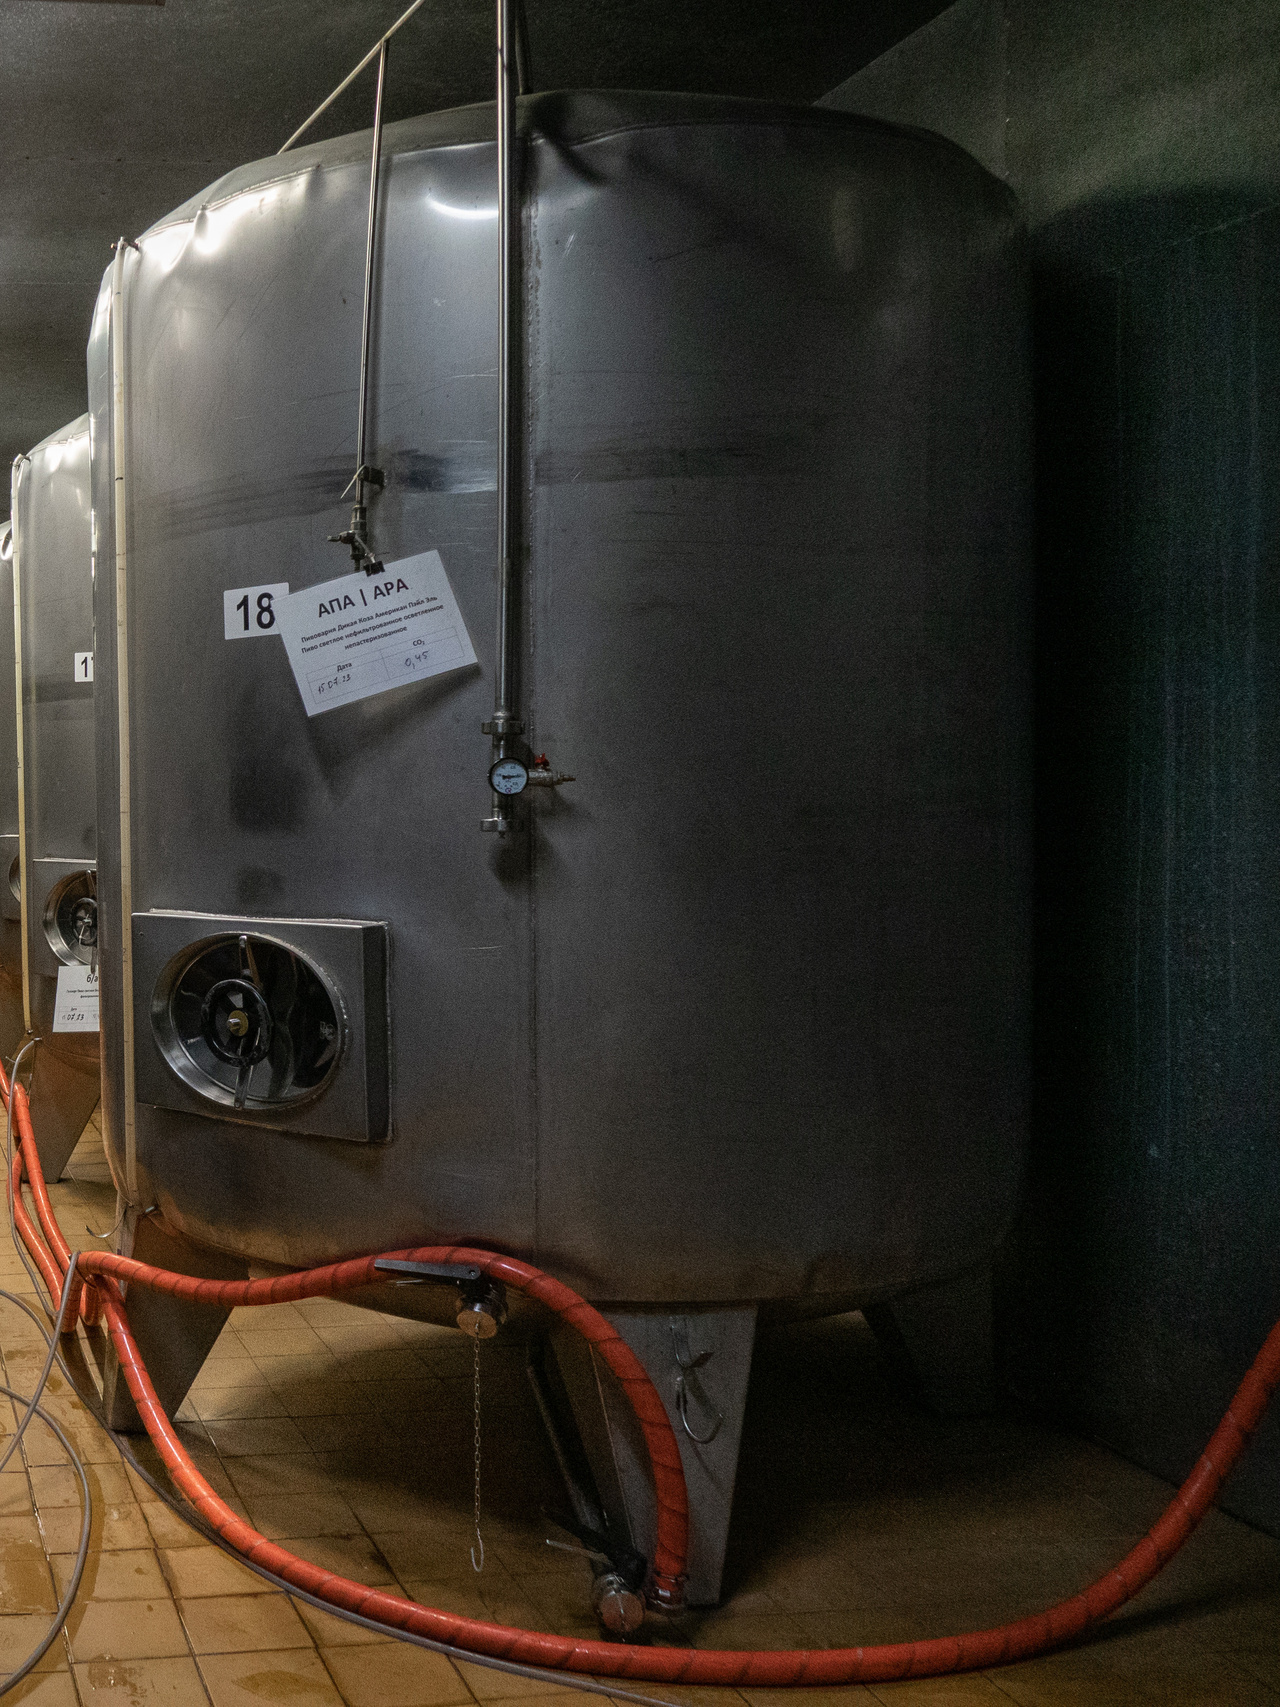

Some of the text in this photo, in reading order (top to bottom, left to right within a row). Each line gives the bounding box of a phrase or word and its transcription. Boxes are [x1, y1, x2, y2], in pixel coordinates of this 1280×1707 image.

[236, 592, 276, 631] 18
[318, 595, 356, 618] АПА
[301, 595, 438, 643] Пивоварня Дикая Коза Американ Пэйл Эль
[301, 644, 318, 654] Пиво
[319, 636, 344, 648] светлое
[345, 617, 403, 640] нефильтрованное
[344, 626, 408, 650] непастеризованное
[81, 656, 94, 678] 1
[337, 662, 352, 672] Дата
